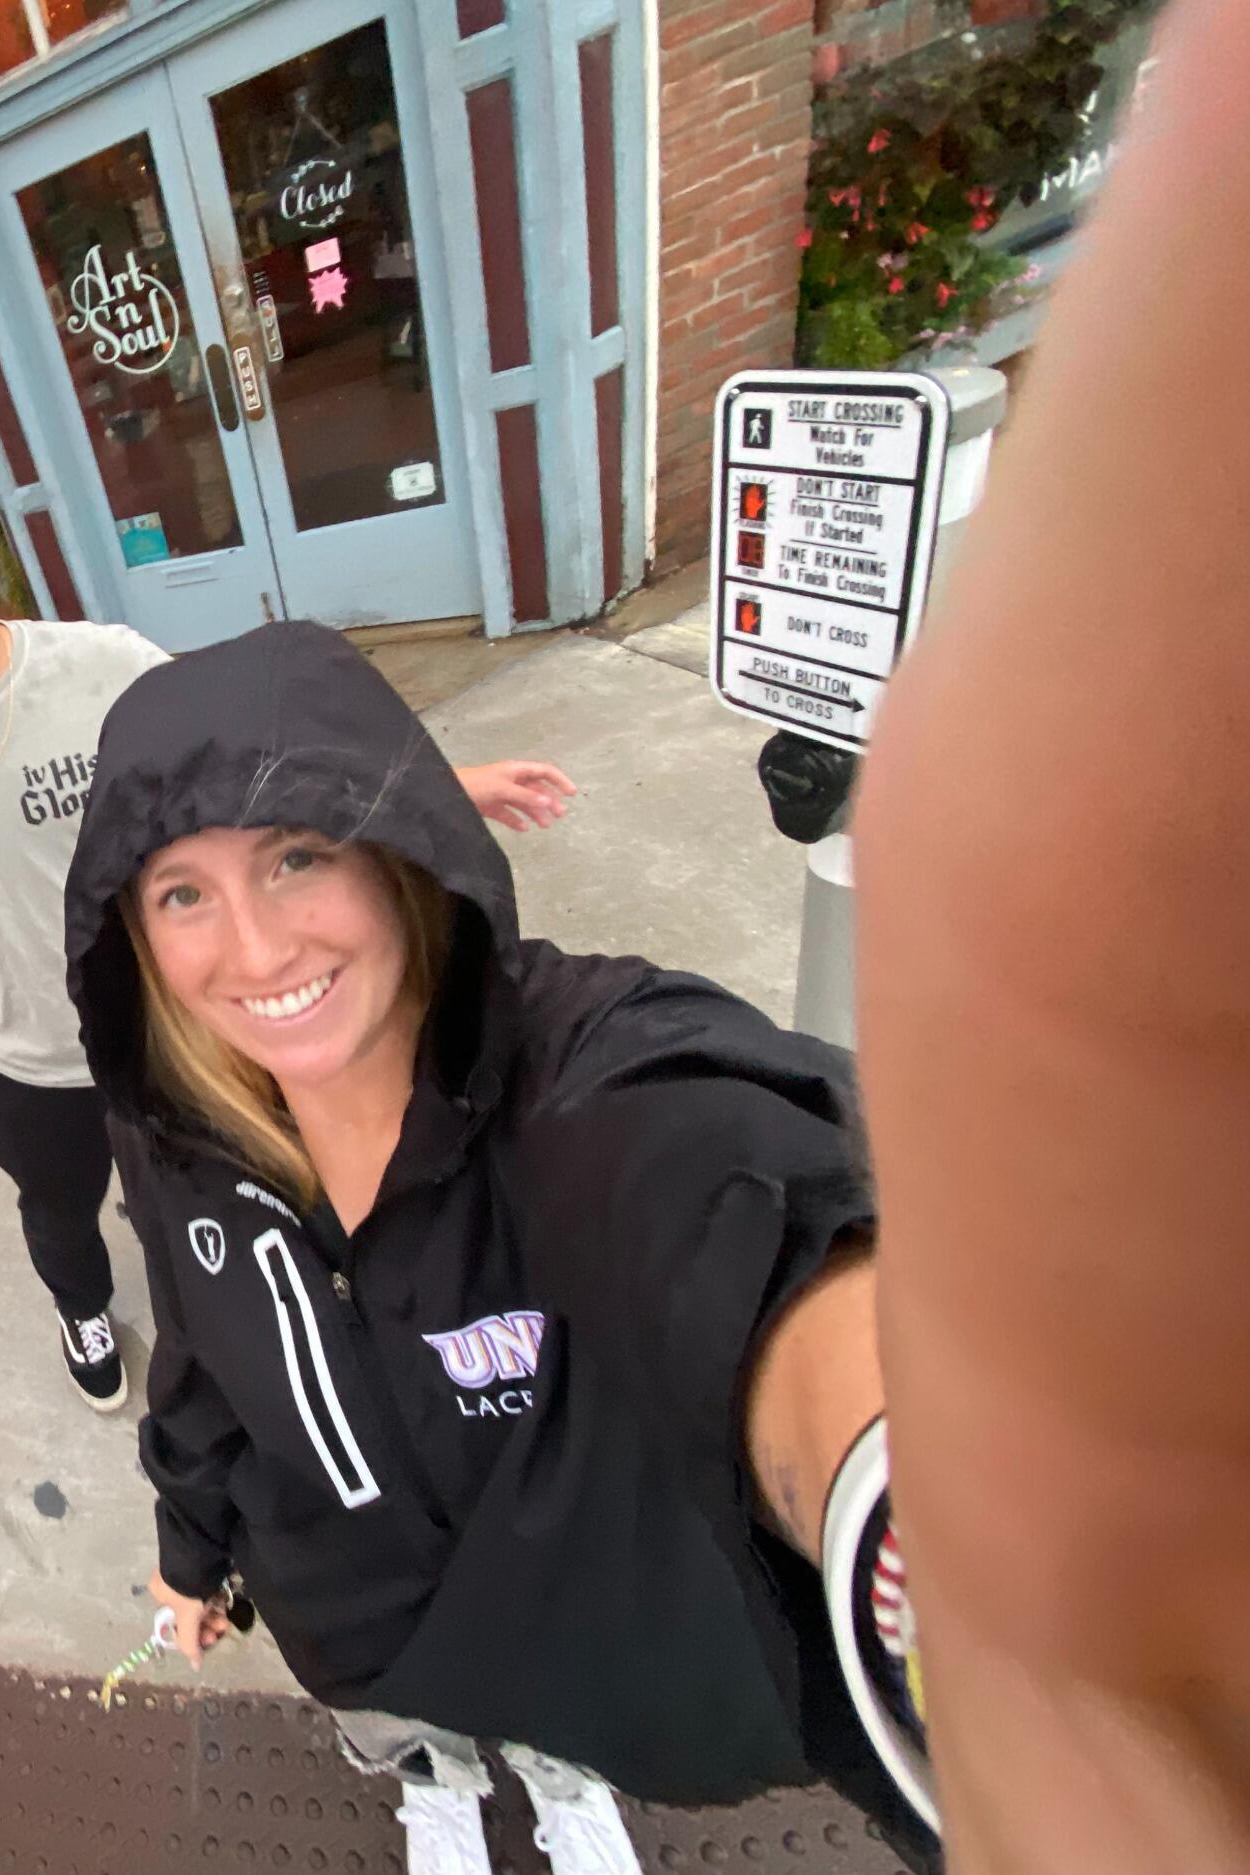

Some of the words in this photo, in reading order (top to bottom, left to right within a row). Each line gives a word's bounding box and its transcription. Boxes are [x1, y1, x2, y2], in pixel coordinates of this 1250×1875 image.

[281, 169, 352, 219] Closed
[68, 244, 145, 333] Art
[88, 287, 170, 364] Soul
[237, 350, 258, 407] PUSH
[788, 400, 826, 418] START
[834, 402, 904, 423] CROSSING
[810, 426, 845, 444] Watch
[854, 428, 874, 446] For
[816, 447, 865, 467] Vehicles
[797, 477, 833, 496] DON'T
[841, 482, 881, 502] START
[790, 498, 824, 519] Finish
[832, 504, 883, 531] Crossing
[821, 523, 864, 543] Started
[780, 545, 806, 564] TIME
[815, 551, 887, 577] REMAINING
[779, 564, 789, 580] To
[798, 567, 828, 587] Finish
[837, 575, 886, 602] Crossing
[787, 616, 821, 637] DON'T
[829, 626, 868, 648] CROSS
[753, 657, 789, 679] PUSH
[795, 669, 851, 696] BUTTON
[764, 687, 780, 703] TO
[786, 695, 833, 719] CROSS
